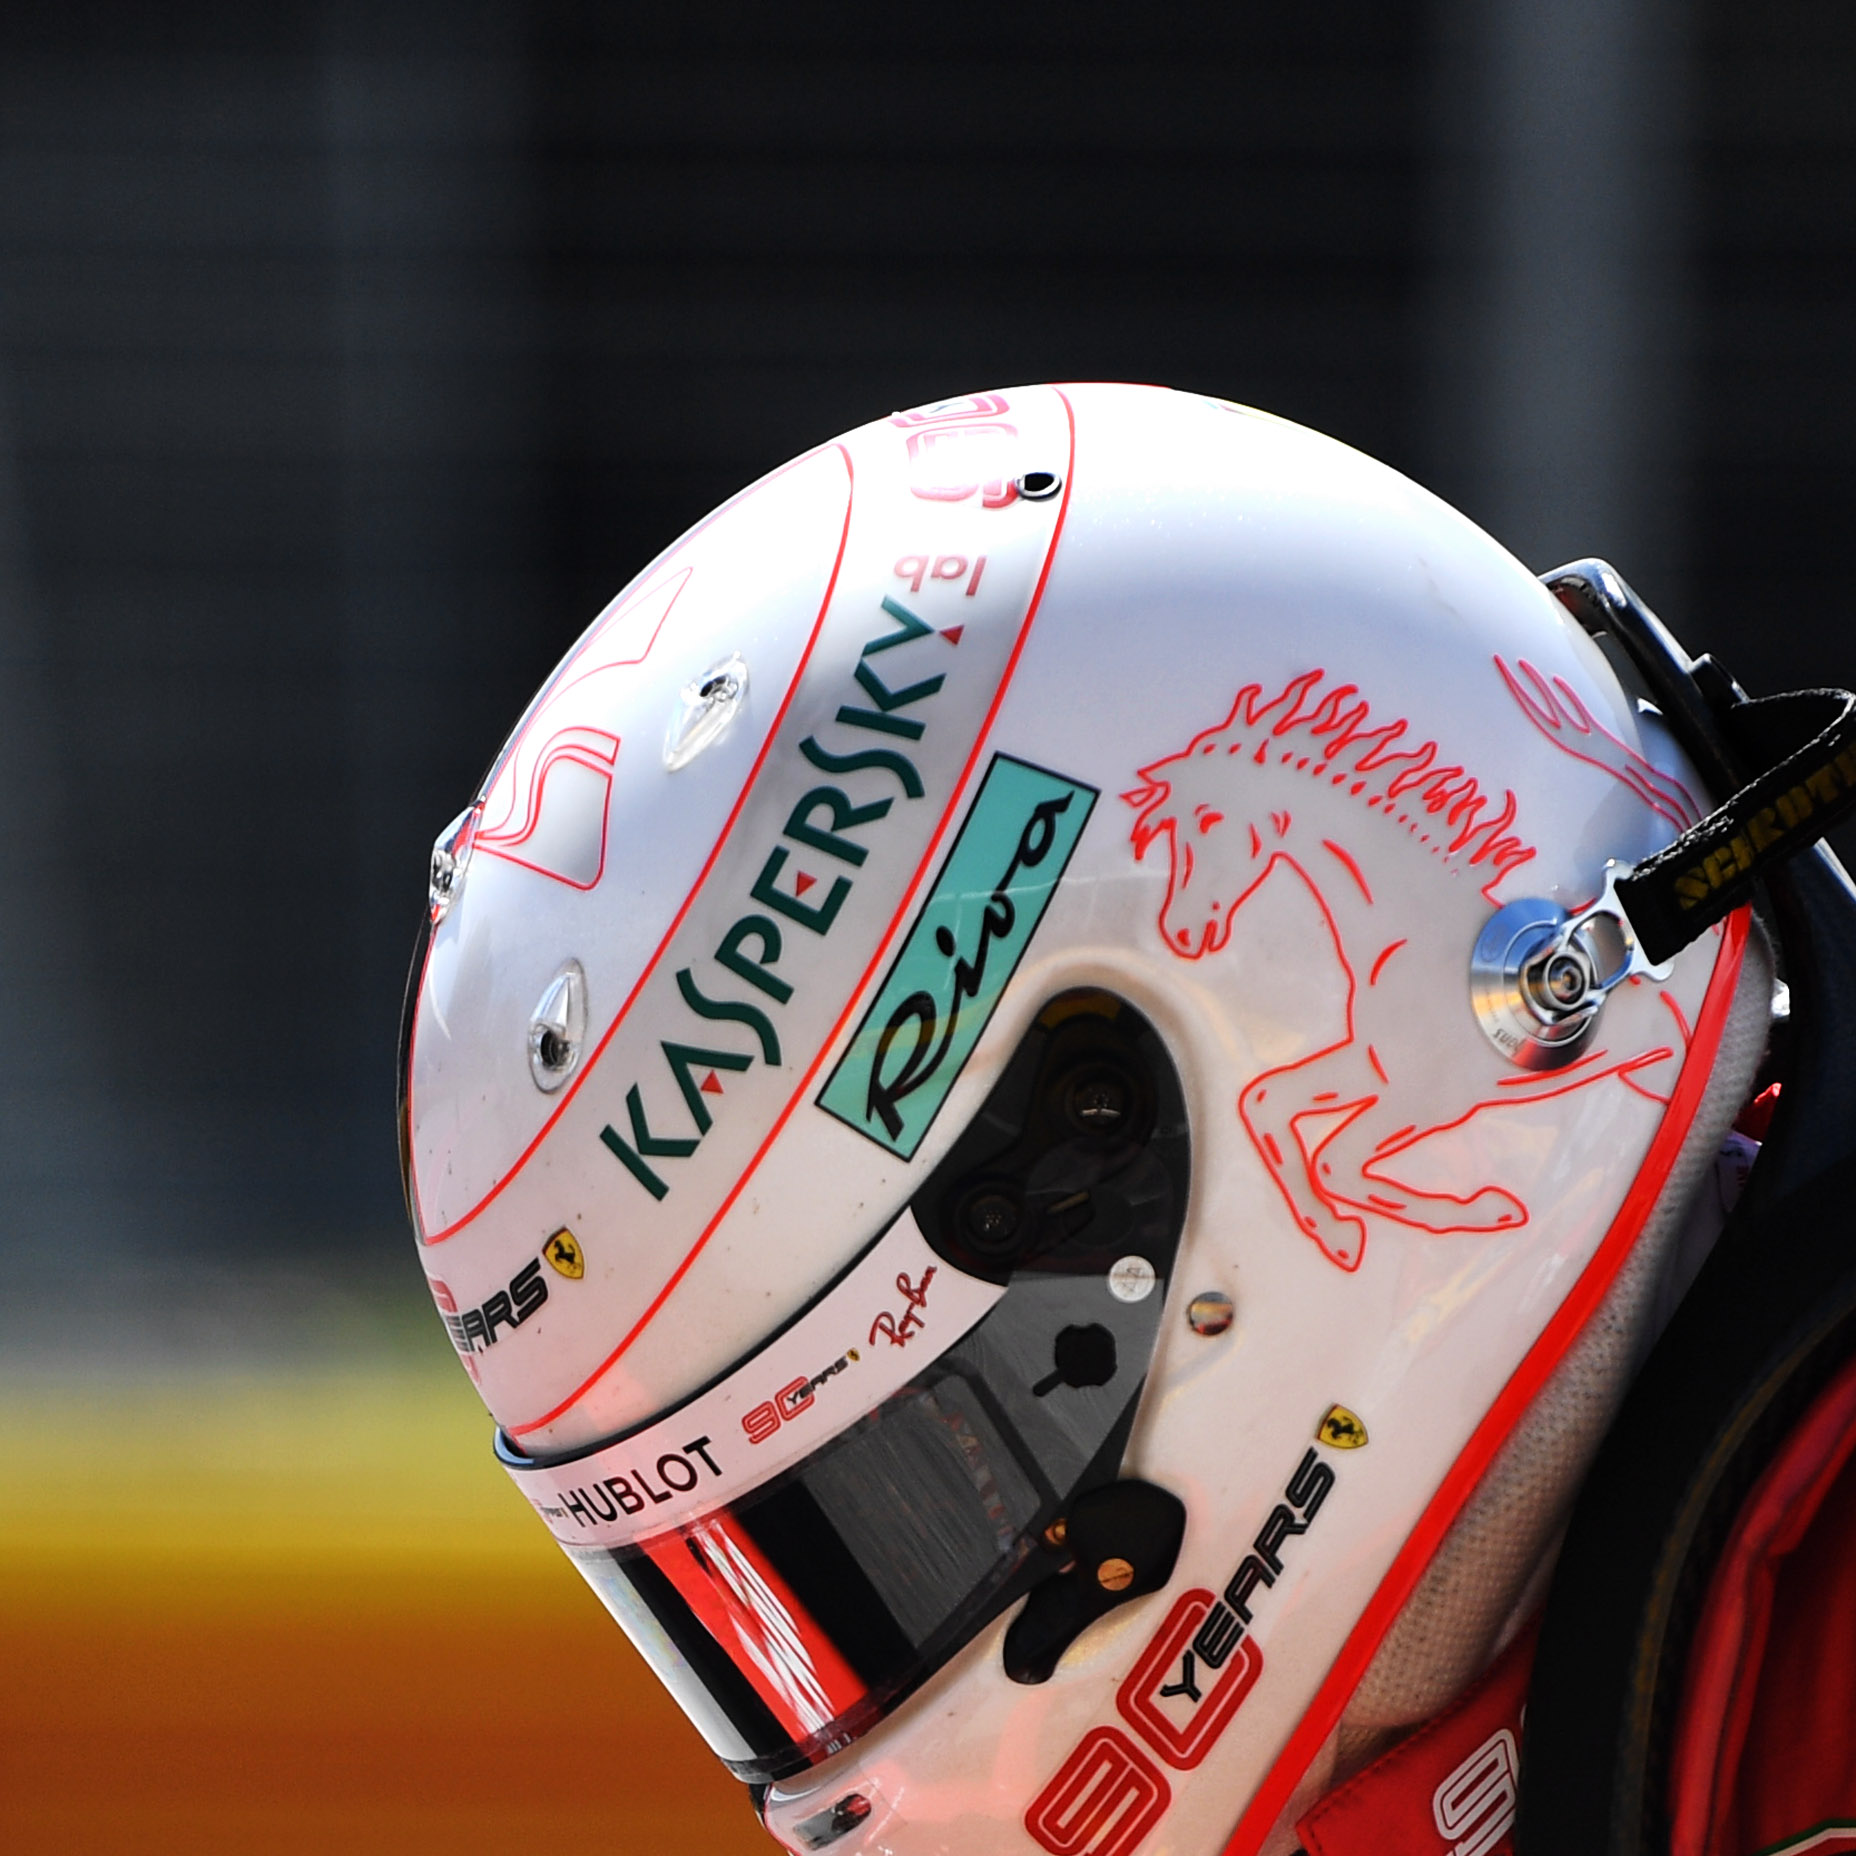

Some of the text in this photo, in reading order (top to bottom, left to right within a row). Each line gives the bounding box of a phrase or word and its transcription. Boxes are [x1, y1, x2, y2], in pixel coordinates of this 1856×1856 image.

[893, 554, 988, 597] lab
[598, 594, 948, 1203] KASPERSKY
[866, 789, 1076, 1143] Riva
[446, 1256, 549, 1353] EARS
[740, 1354, 849, 1445] 90 YEARS
[557, 1435, 723, 1528] HUBLOT
[1160, 1447, 1338, 1705] YEARS
